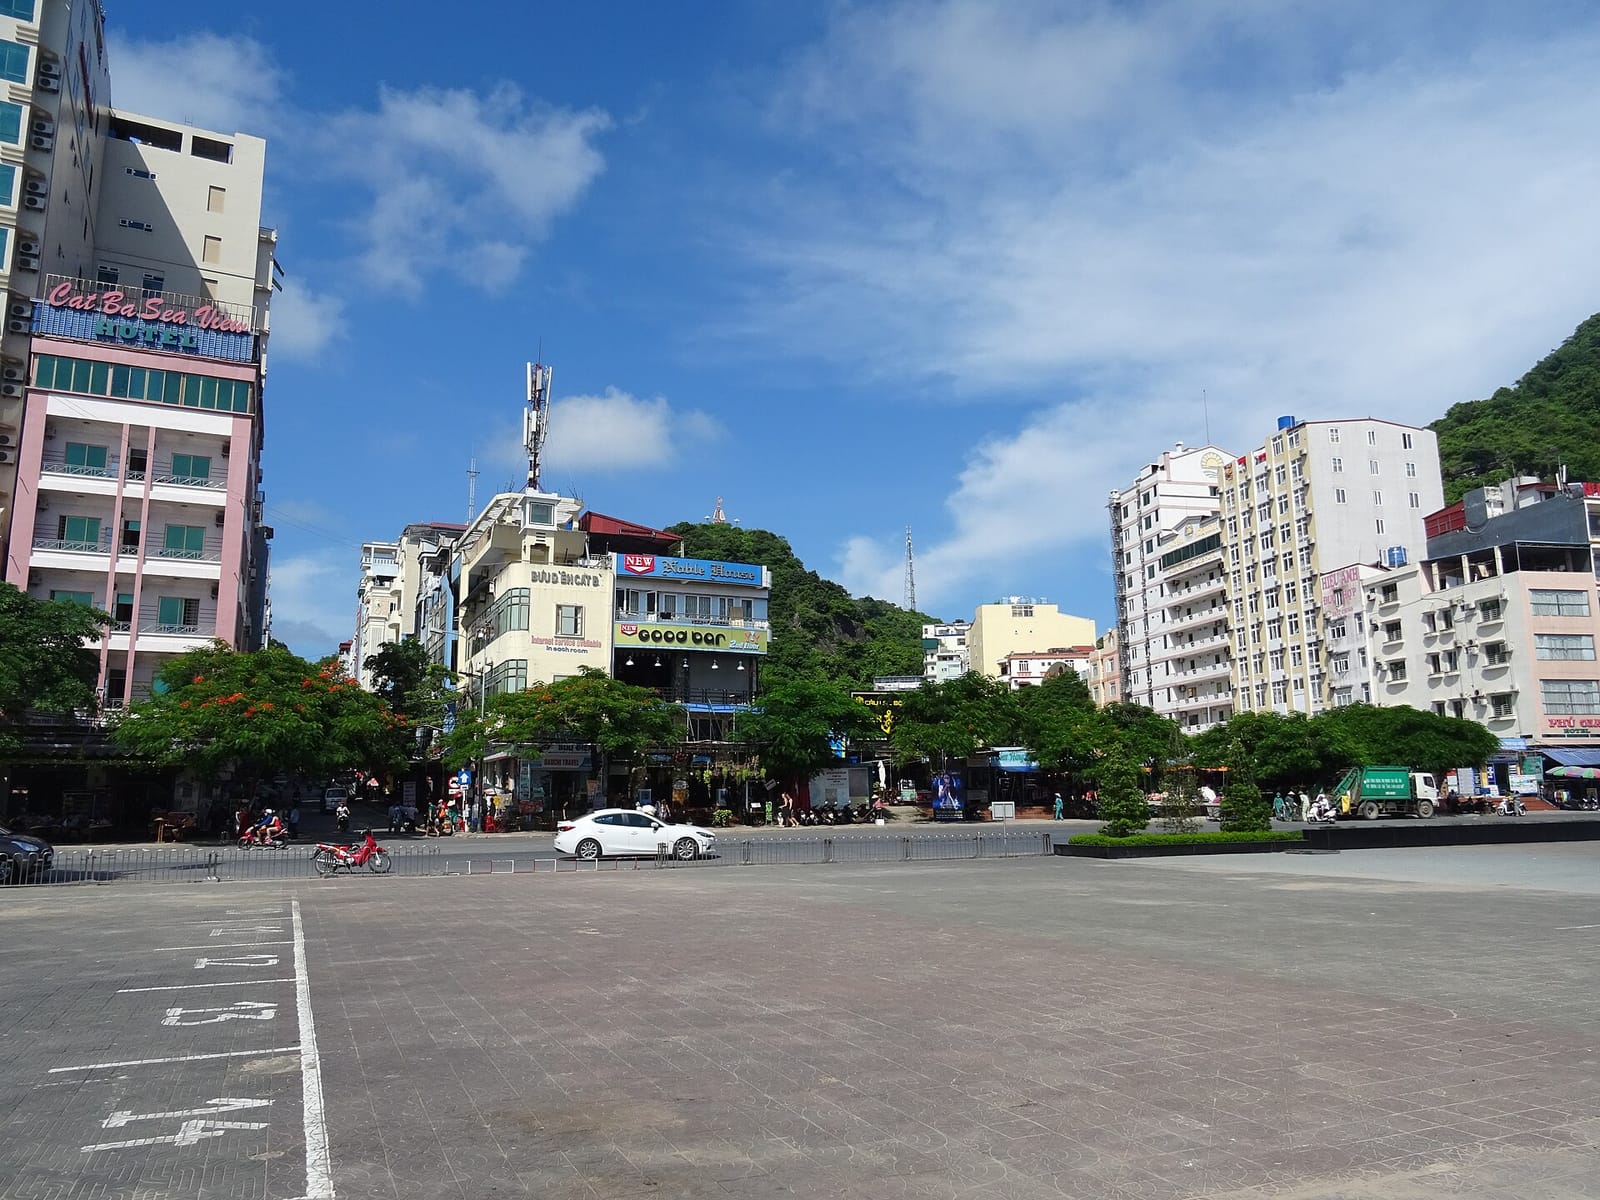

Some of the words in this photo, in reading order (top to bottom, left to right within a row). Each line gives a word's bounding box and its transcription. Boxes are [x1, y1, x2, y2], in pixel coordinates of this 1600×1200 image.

[48, 282, 97, 311] Cat
[101, 291, 137, 318] Ba
[140, 298, 186, 325] Sea
[194, 305, 249, 333] View
[96, 319, 197, 348] HOTEL
[626, 556, 653, 567] NEW
[662, 560, 705, 576] Noble
[710, 563, 755, 581] House
[160, 1001, 278, 1026] 13
[80, 1098, 276, 1153] 14
